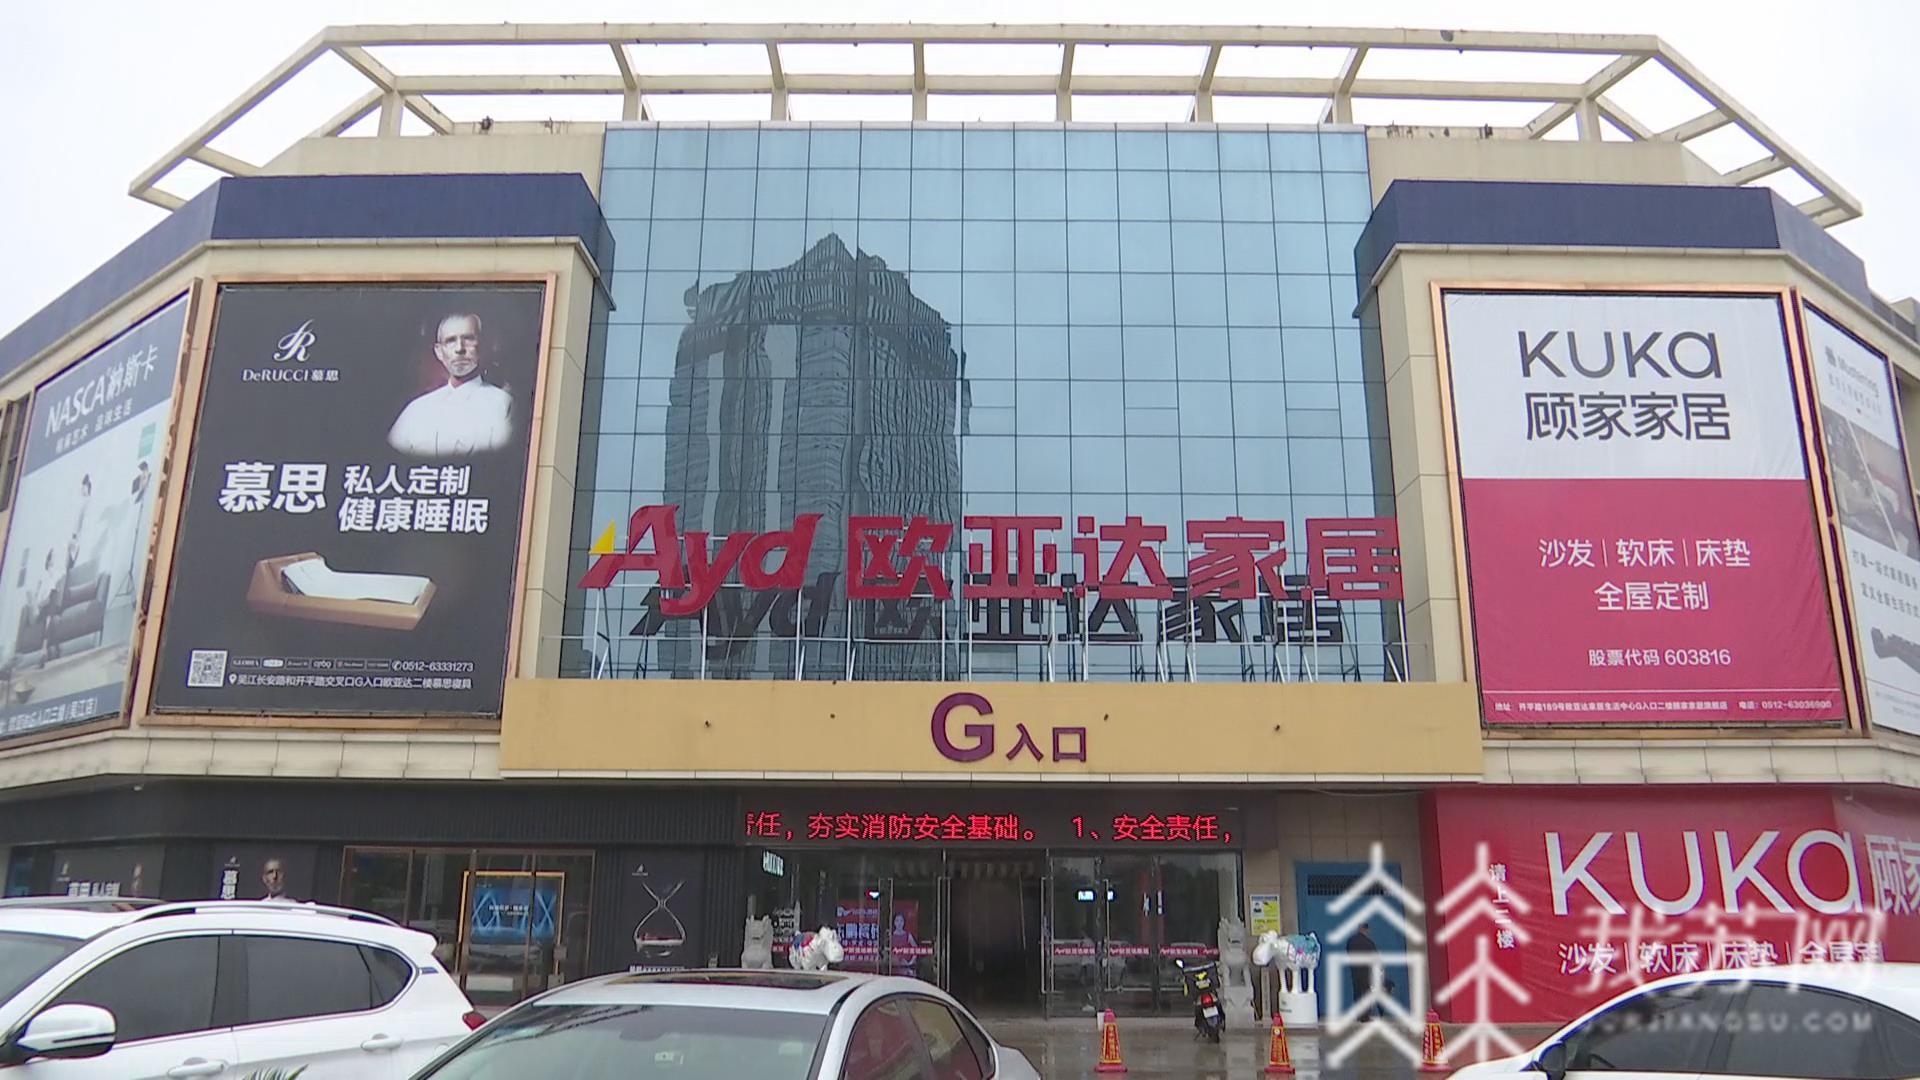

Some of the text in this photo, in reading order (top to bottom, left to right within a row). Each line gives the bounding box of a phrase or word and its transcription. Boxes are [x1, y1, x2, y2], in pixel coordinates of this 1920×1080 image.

[242, 368, 340, 382] DeRUCCI 慕思
[45, 375, 106, 438] NASCA
[1526, 392, 1731, 442] 顾家家居
[218, 462, 328, 514] 慕思
[344, 465, 471, 496] 私人定制
[338, 497, 490, 535] 健康睡眠
[577, 504, 1402, 616] Ayd 欧亚达家居
[1537, 538, 1751, 569] 沙发 软床 床垫
[1594, 581, 1709, 612] 全屋定制
[1588, 649, 1731, 667] 股票代码 603816
[931, 692, 1088, 763] G入口
[1637, 941, 1698, 973] 软床
